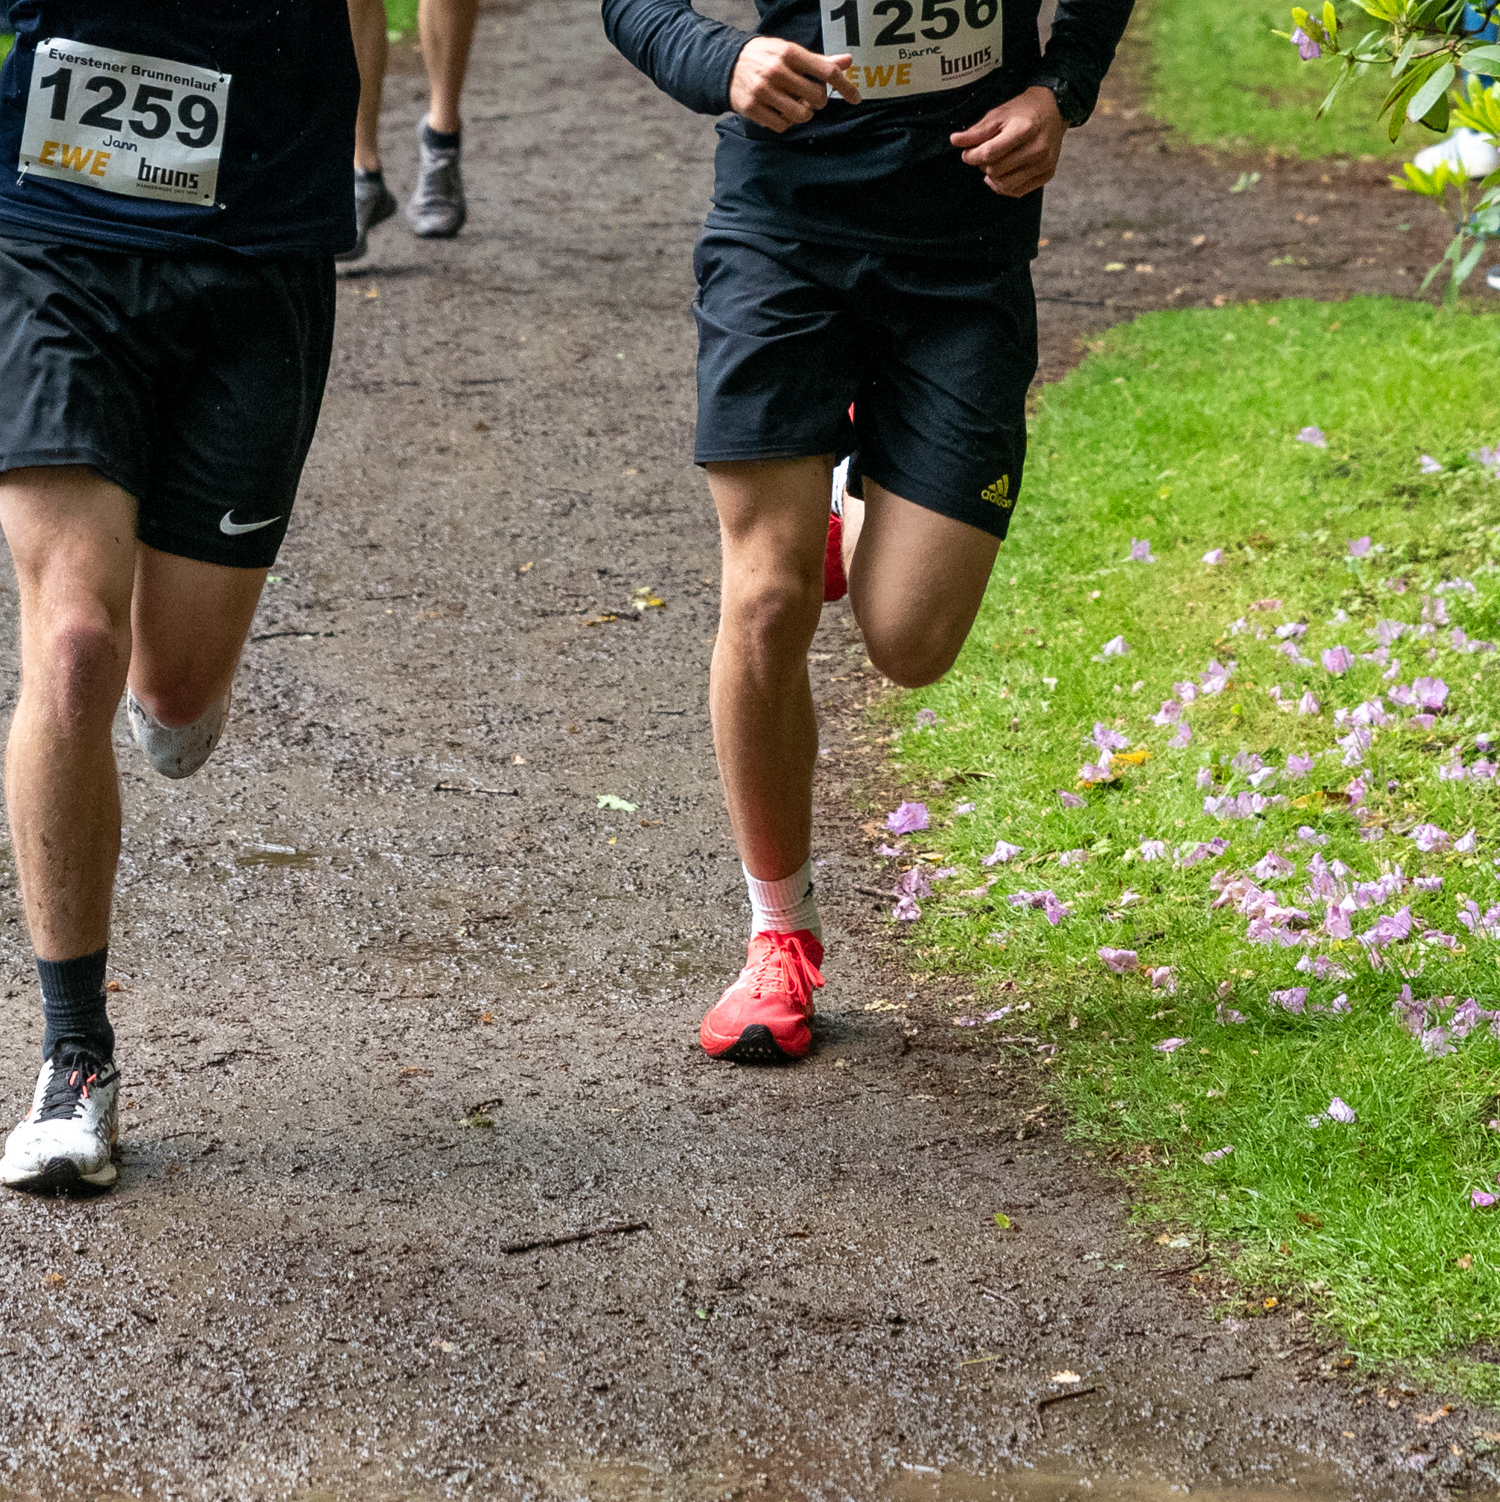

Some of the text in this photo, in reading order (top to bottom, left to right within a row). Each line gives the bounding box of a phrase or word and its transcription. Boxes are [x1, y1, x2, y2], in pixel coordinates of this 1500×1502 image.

[899, 45, 943, 60] Bjarne
[940, 45, 992, 75] bruns
[48, 48, 218, 93] Everstener Brunnenlauf
[846, 62, 912, 89] EWE
[39, 66, 219, 149] 1259
[38, 140, 111, 177] EWE
[102, 135, 138, 153] Jann
[137, 157, 199, 189] bruns
